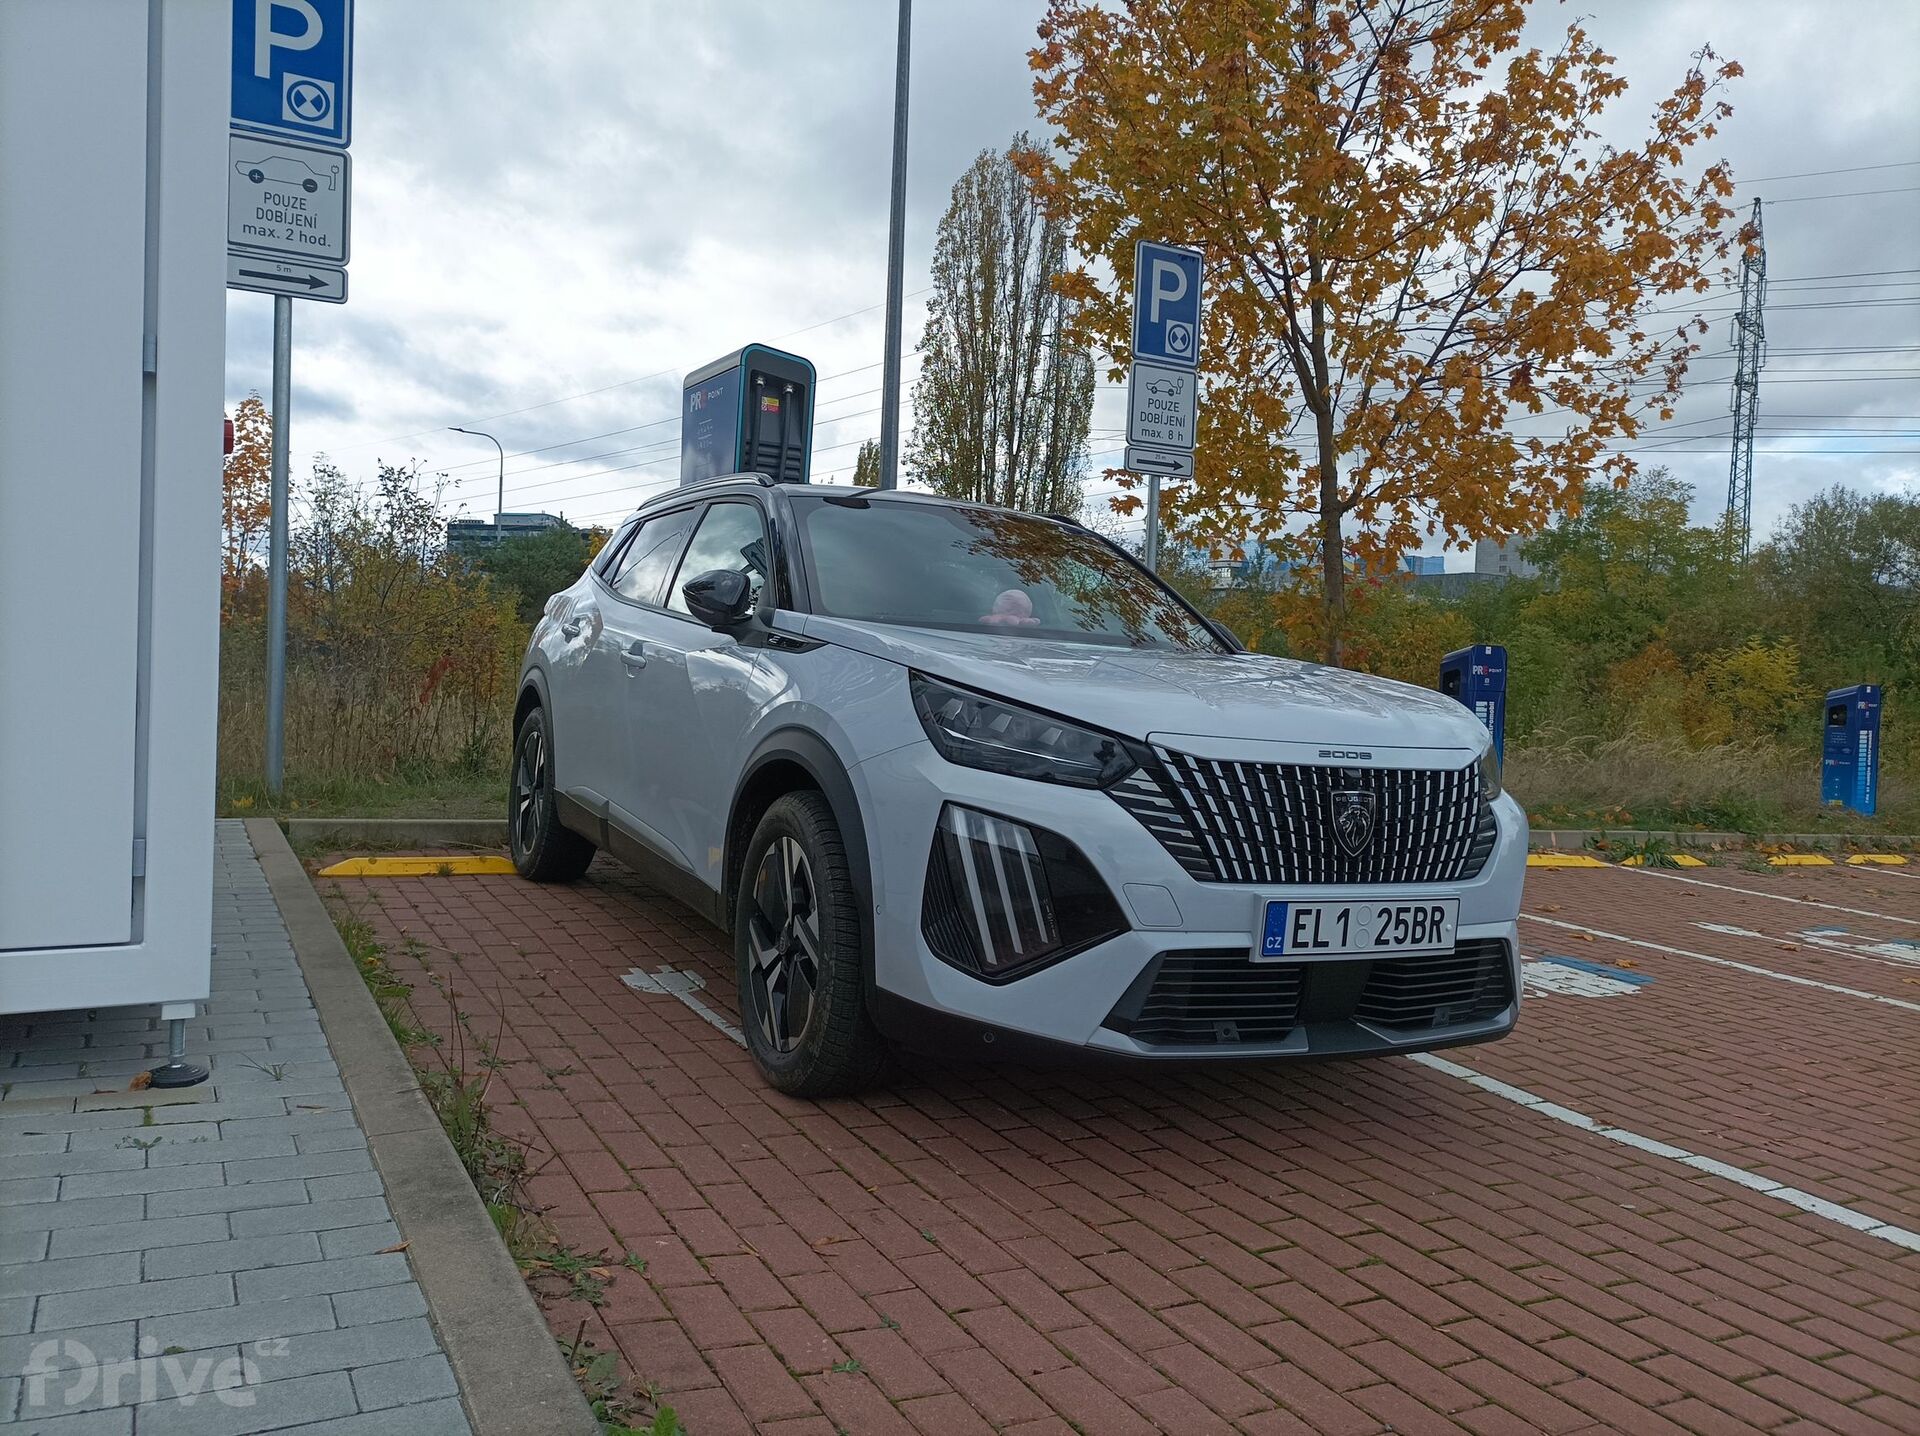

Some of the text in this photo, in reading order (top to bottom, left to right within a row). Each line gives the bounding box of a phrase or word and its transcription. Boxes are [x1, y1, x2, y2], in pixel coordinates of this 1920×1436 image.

[254, 0, 323, 79] P
[264, 191, 307, 210] POUZE
[256, 207, 317, 229] DOBÍJENÍ
[243, 224, 331, 247] max. 2 hod.
[1150, 258, 1188, 323] P
[1147, 397, 1180, 413] POUZE
[1140, 411, 1186, 428] DOBÍJENÍ
[1141, 428, 1184, 441] max. 8 h
[1318, 750, 1372, 760] 2008
[1374, 906, 1445, 946] 25BR
[1266, 936, 1282, 949] CZ
